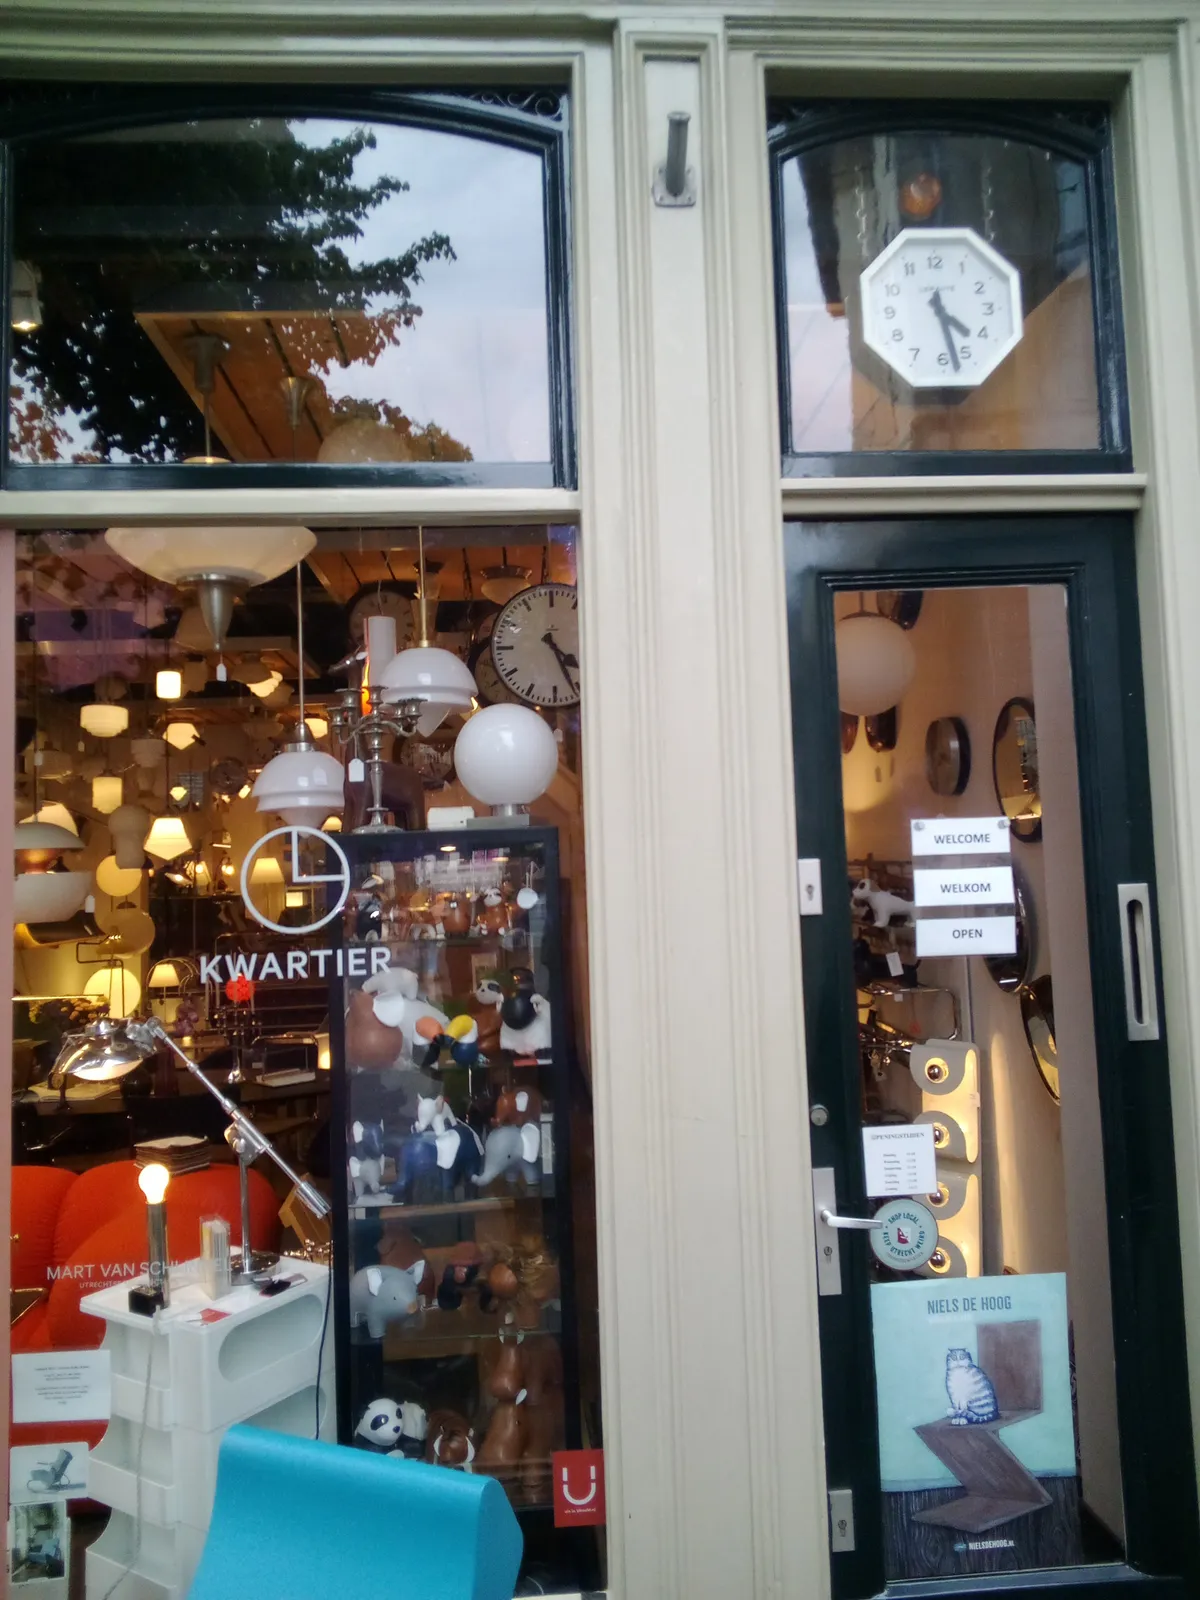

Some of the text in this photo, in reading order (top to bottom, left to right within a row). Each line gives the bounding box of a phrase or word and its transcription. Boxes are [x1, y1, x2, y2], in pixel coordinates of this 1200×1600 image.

[904, 262, 916, 276] 11
[927, 256, 943, 270] 12
[958, 261, 965, 275] 1
[884, 283, 900, 297] 10
[974, 281, 985, 295] 2
[884, 306, 896, 320] 9
[981, 302, 995, 315] 3
[891, 329, 904, 342] 8
[977, 326, 989, 339] 4
[908, 347, 921, 361] 7
[937, 352, 949, 366] 6
[960, 346, 972, 359] 5
[934, 833, 991, 844] WELCOME
[940, 883, 992, 893] WELKOM
[952, 928, 983, 939] OPEN
[200, 947, 392, 984] KWARTIER
[902, 1212, 919, 1225] LOCAL
[890, 1245, 915, 1257] UTRECHT
[47, 1264, 95, 1281] MART
[100, 1262, 135, 1278] VAN
[927, 1295, 1012, 1314] NIELS DE HOOG
